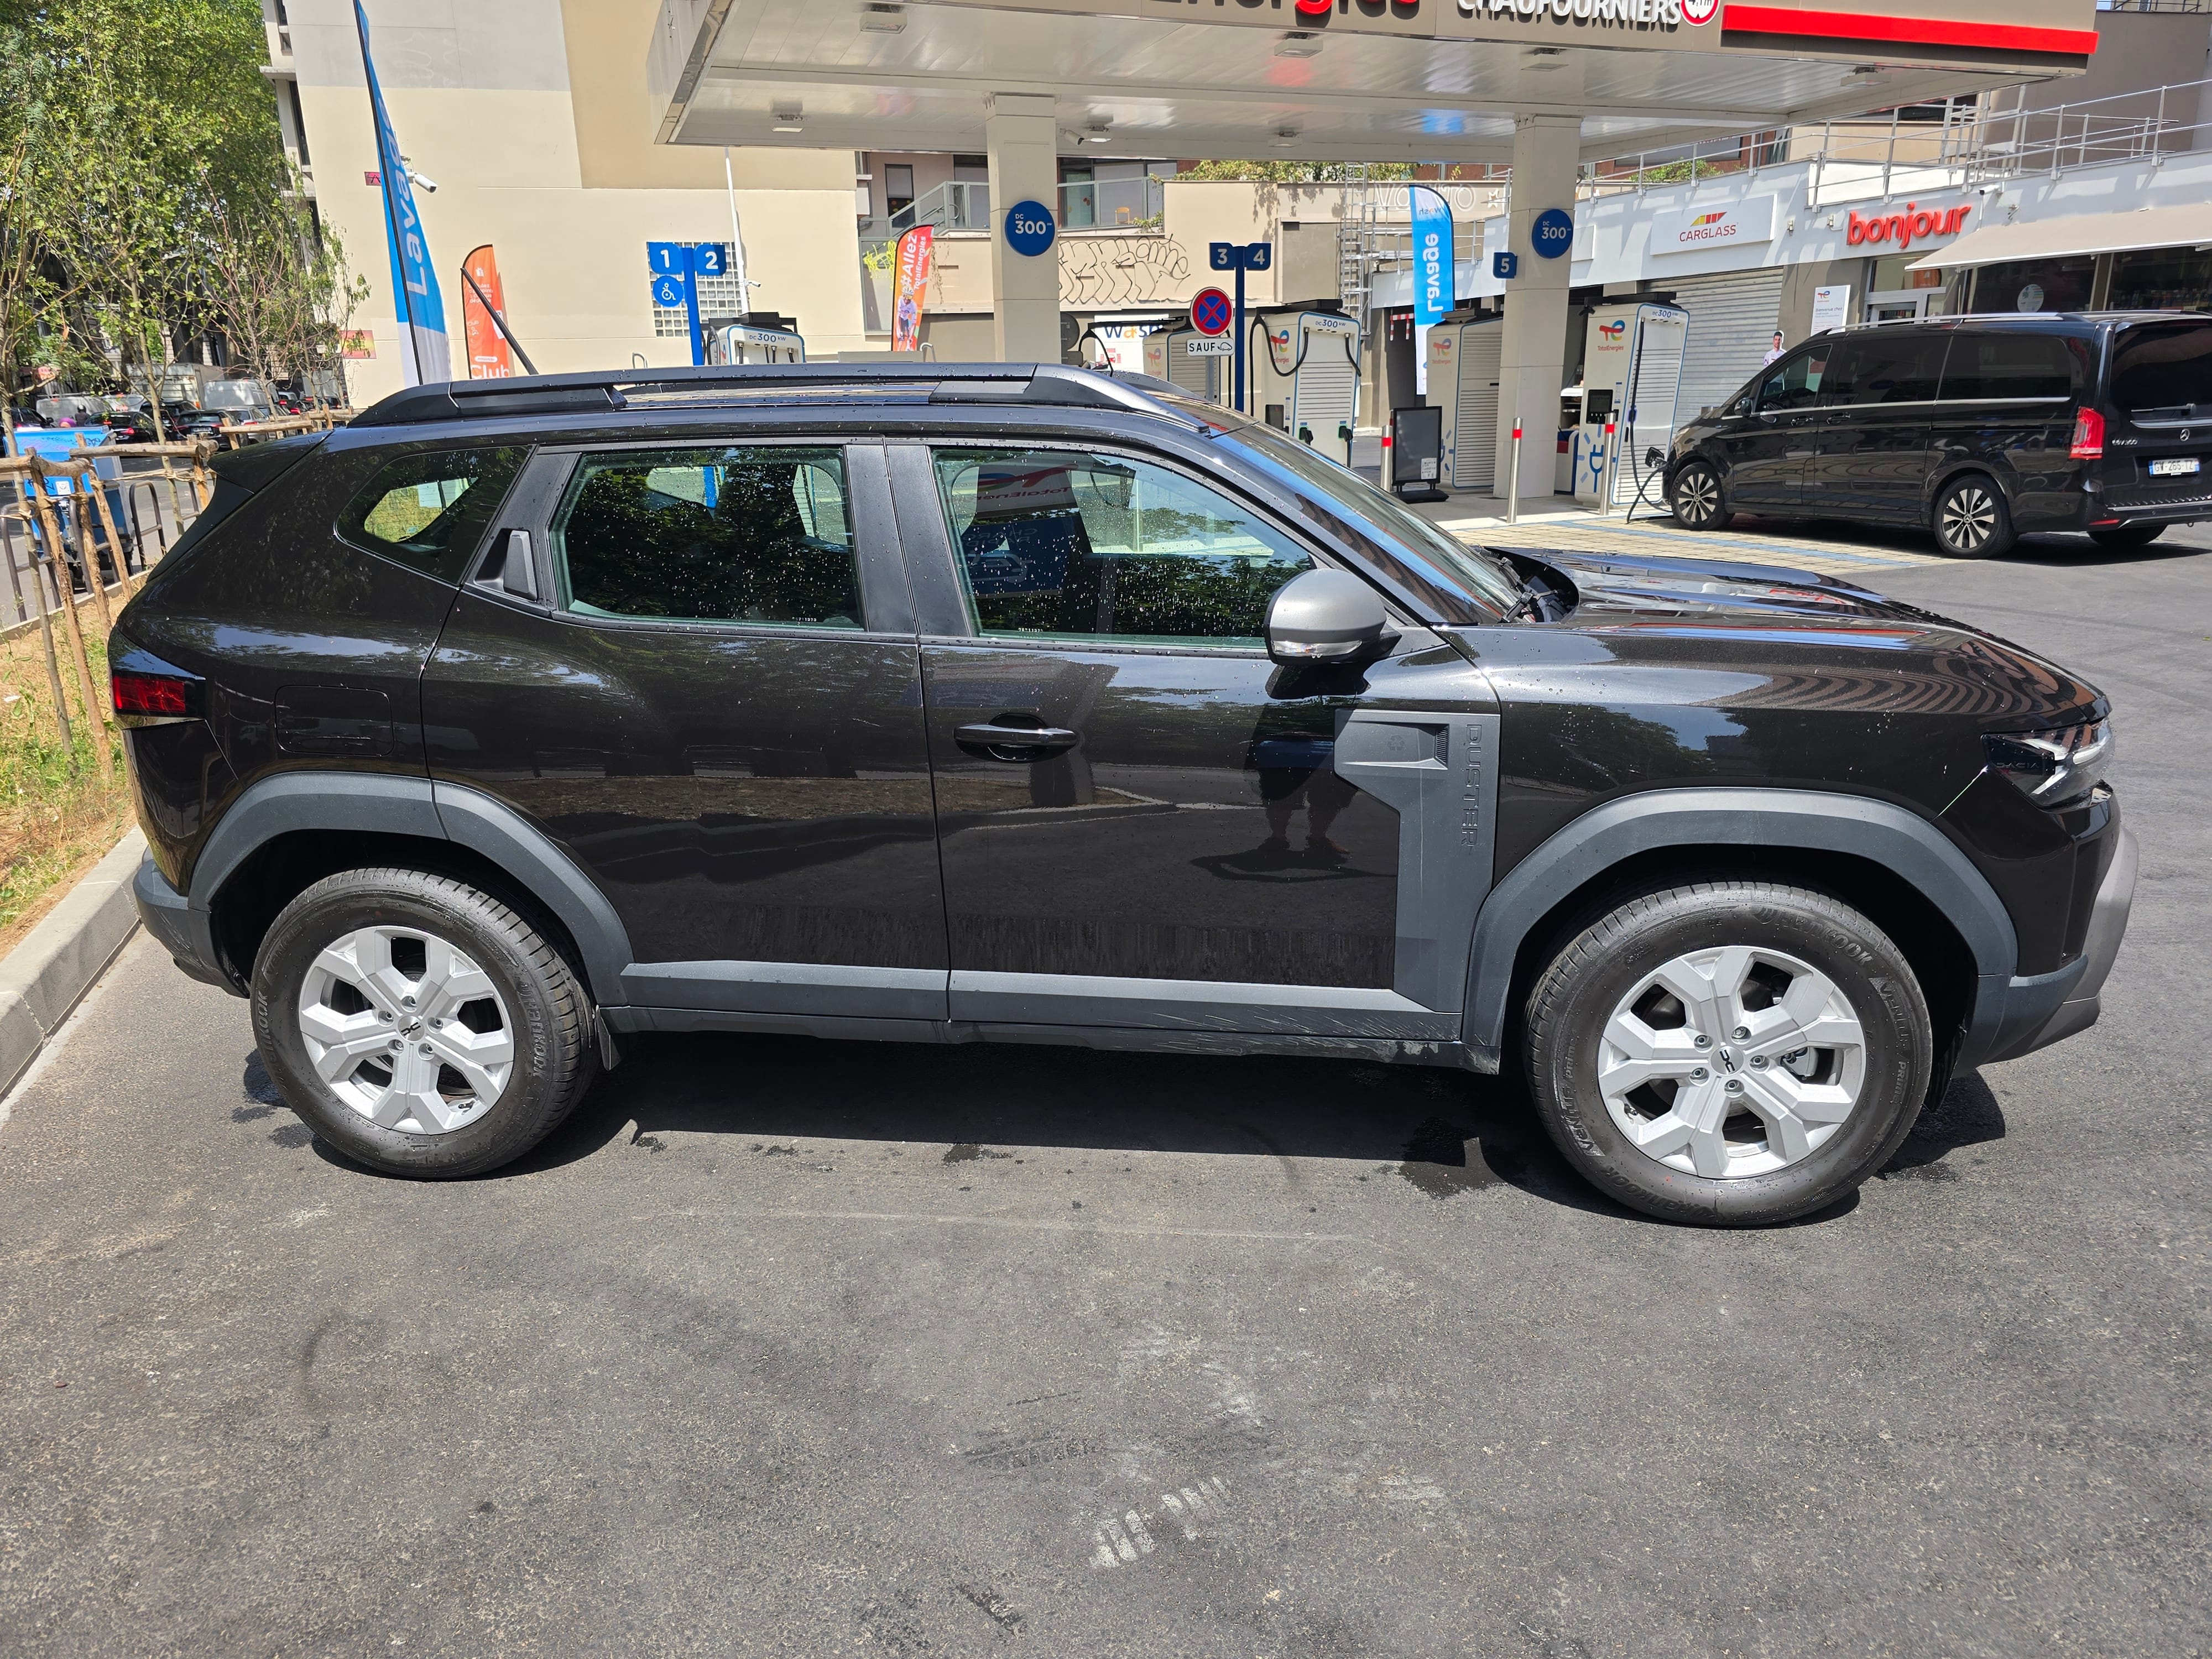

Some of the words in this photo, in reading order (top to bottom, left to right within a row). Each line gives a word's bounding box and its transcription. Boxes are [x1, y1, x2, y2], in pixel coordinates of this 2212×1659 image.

[378, 97, 427, 296] Lavage
[1015, 221, 1046, 234] 300
[1541, 227, 1567, 239] 300
[1679, 225, 1736, 242] CARGLASS
[1846, 202, 1972, 249] bonjour
[660, 249, 670, 268] 1
[705, 251, 719, 270] 2
[900, 234, 917, 286] #Allez
[914, 236, 926, 290] TotalEnergies
[1217, 248, 1228, 265] 3
[1253, 249, 1265, 265] 4
[1500, 258, 1510, 273] 5
[1658, 310, 1672, 318] 300
[1322, 319, 1338, 328] 300
[757, 333, 777, 342] 300
[1189, 342, 1215, 352] SAUF
[1461, 724, 1483, 846] DUSTER
